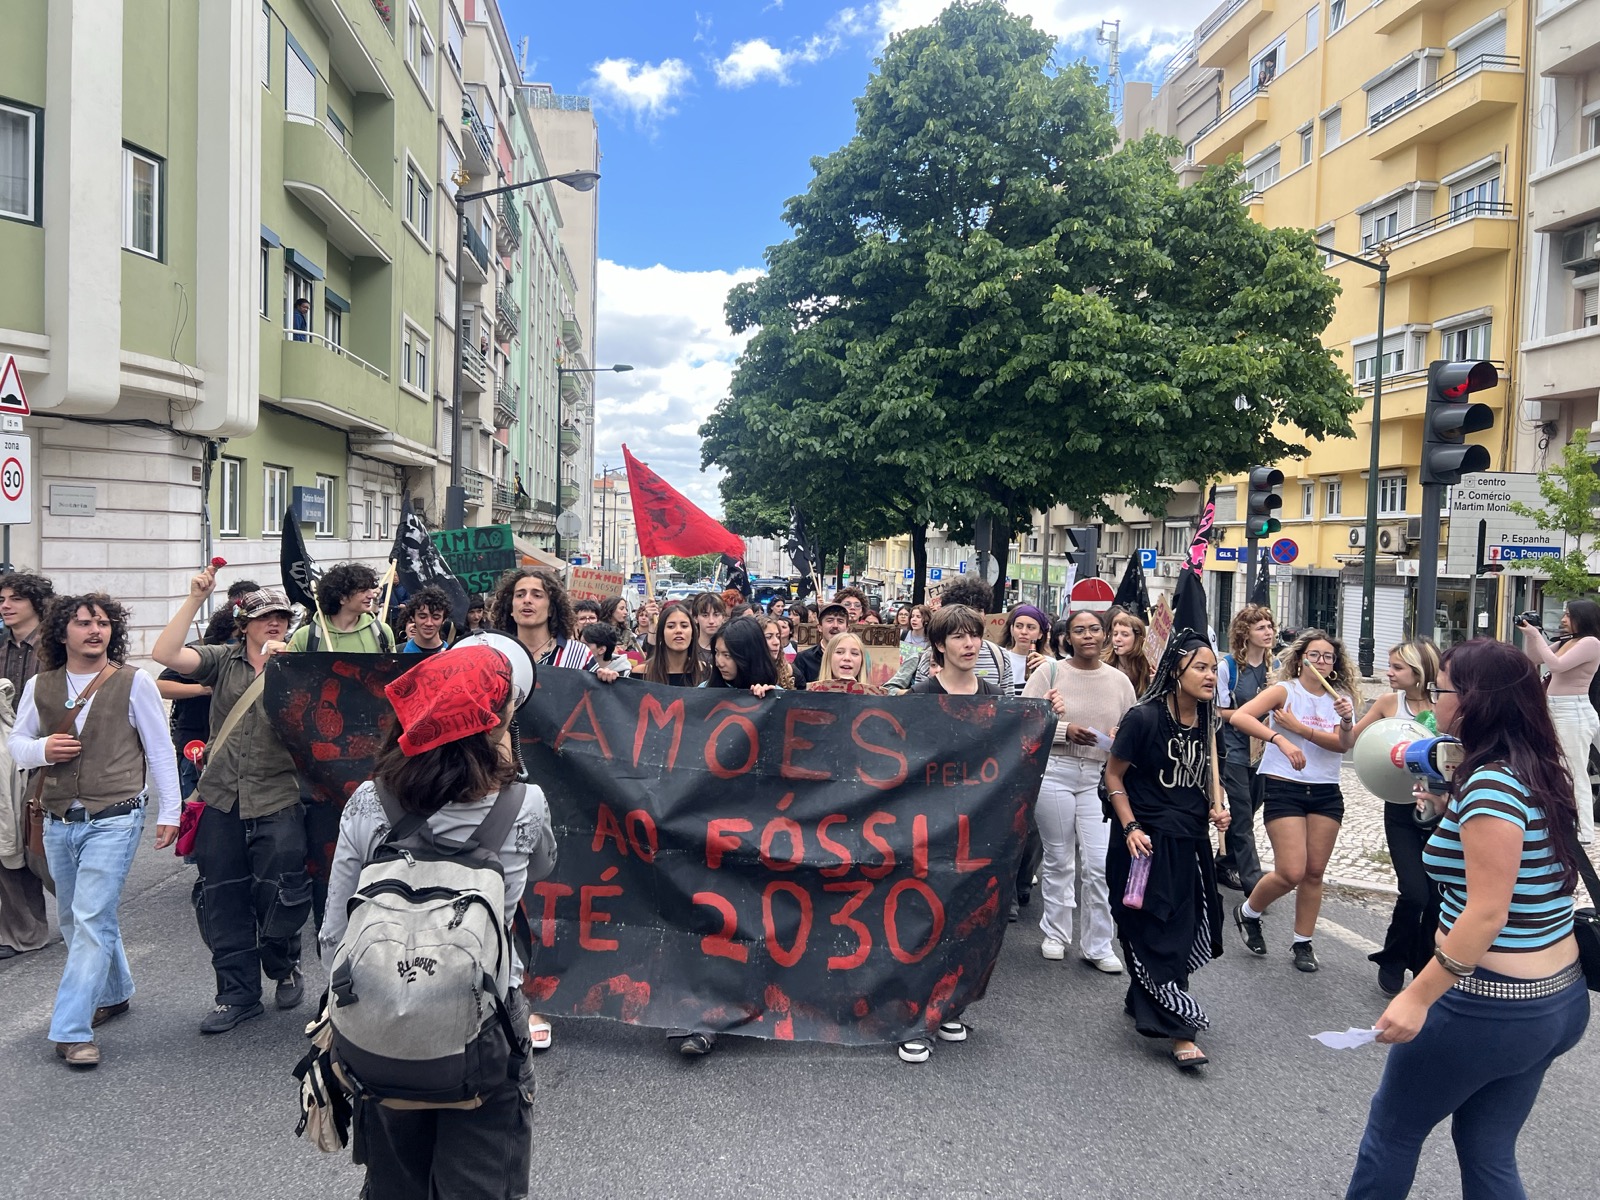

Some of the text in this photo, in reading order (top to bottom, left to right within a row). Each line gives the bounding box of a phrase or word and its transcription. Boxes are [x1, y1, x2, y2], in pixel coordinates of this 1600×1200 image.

[4, 441, 20, 450] zona
[4, 470, 21, 488] 30
[1477, 478, 1506, 486] centro
[1458, 490, 1511, 501] P. Comércio
[1453, 501, 1485, 511] Martim
[1501, 534, 1550, 545] P. Espanha
[1141, 551, 1152, 567] P
[1503, 549, 1560, 560] Cp. Pequeno
[990, 618, 1006, 626] AO
[519, 682, 999, 790] AMÕES PELO
[591, 792, 992, 879] AO FÓSSIL
[692, 878, 946, 971] 2030
